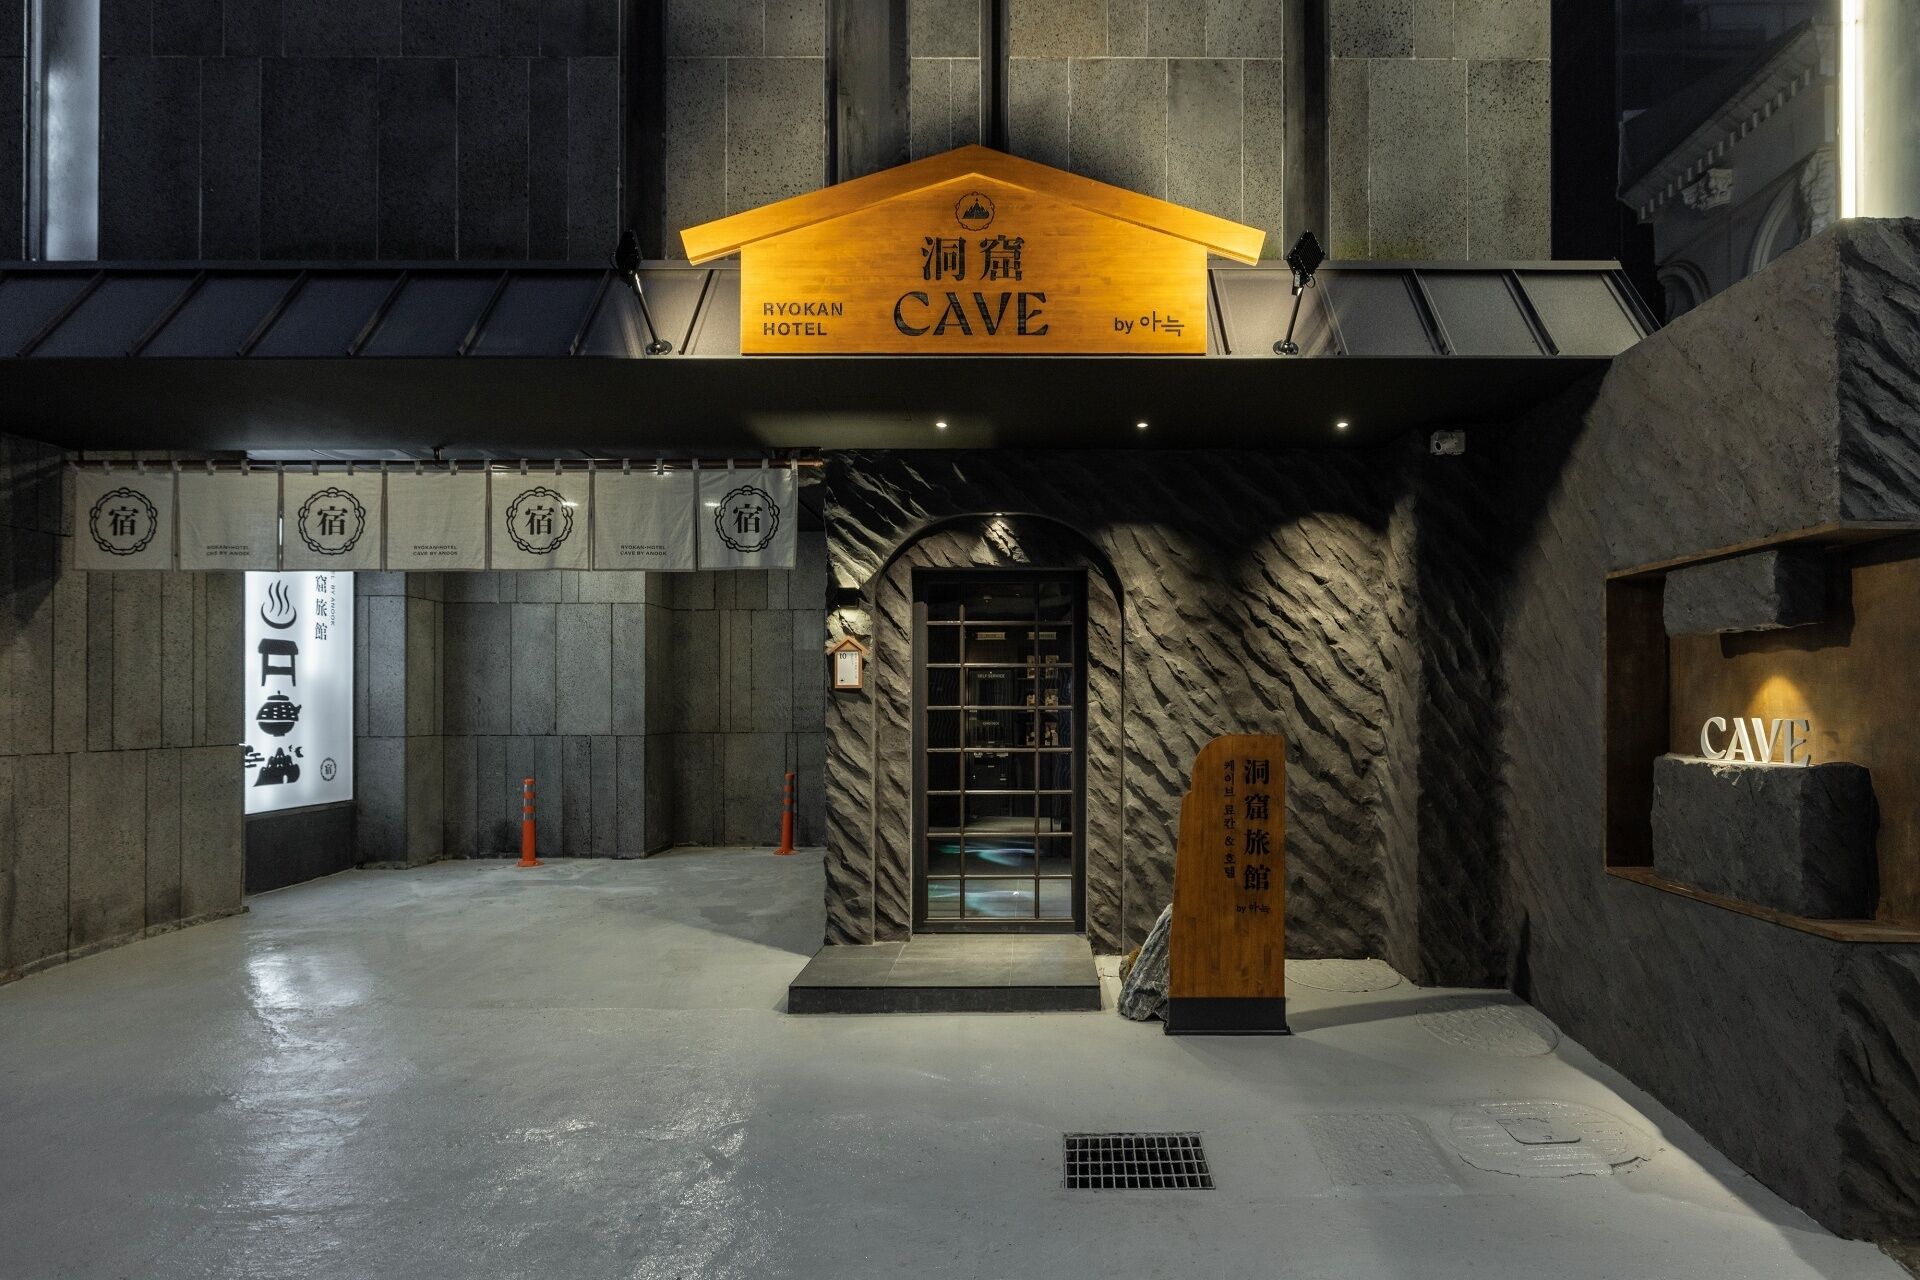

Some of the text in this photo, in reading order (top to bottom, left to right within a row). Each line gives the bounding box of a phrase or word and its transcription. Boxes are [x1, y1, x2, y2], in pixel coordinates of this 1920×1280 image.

[921, 234, 1025, 281] 洞窟
[763, 302, 843, 317] RYOKAN
[893, 290, 1049, 336] CAVE
[1114, 310, 1185, 336] by 아늑
[763, 322, 828, 336] HOTEL
[108, 506, 138, 537] 宿
[316, 506, 349, 537] 宿
[525, 505, 555, 536] 宿
[733, 503, 763, 534] 宿
[1700, 716, 1810, 767] CAVE
[1225, 835, 1235, 846] &
[1244, 759, 1271, 891] 洞窟旅館
[1224, 852, 1235, 879] 호텔
[1236, 904, 1246, 913] by
